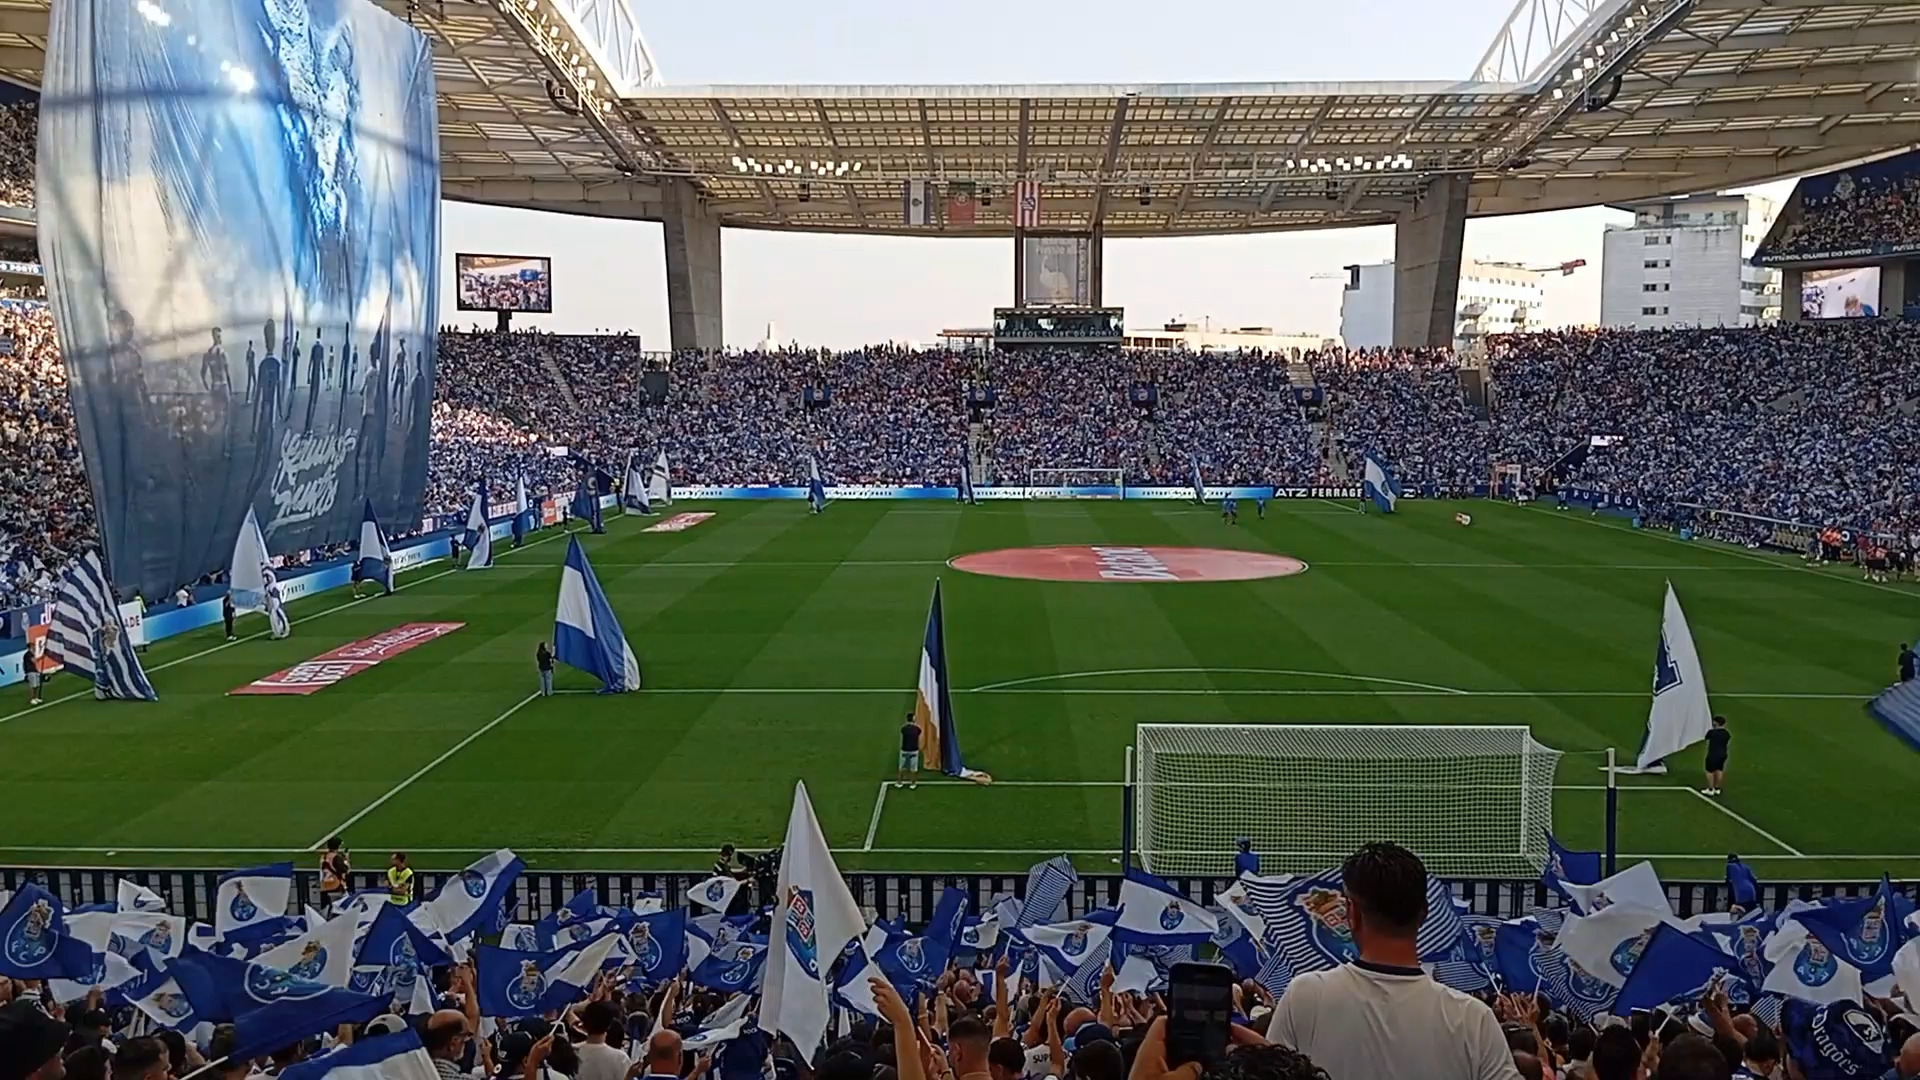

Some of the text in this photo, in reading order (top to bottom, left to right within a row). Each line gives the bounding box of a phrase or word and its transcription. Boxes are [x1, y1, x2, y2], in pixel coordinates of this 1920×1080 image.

[1844, 248, 1872, 256] PORTO
[10, 264, 39, 274] PORTO
[1000, 330, 1038, 338] FUTEBOL
[1089, 330, 1119, 338] PORTO
[1275, 487, 1364, 498] ATZ FERRAGE
